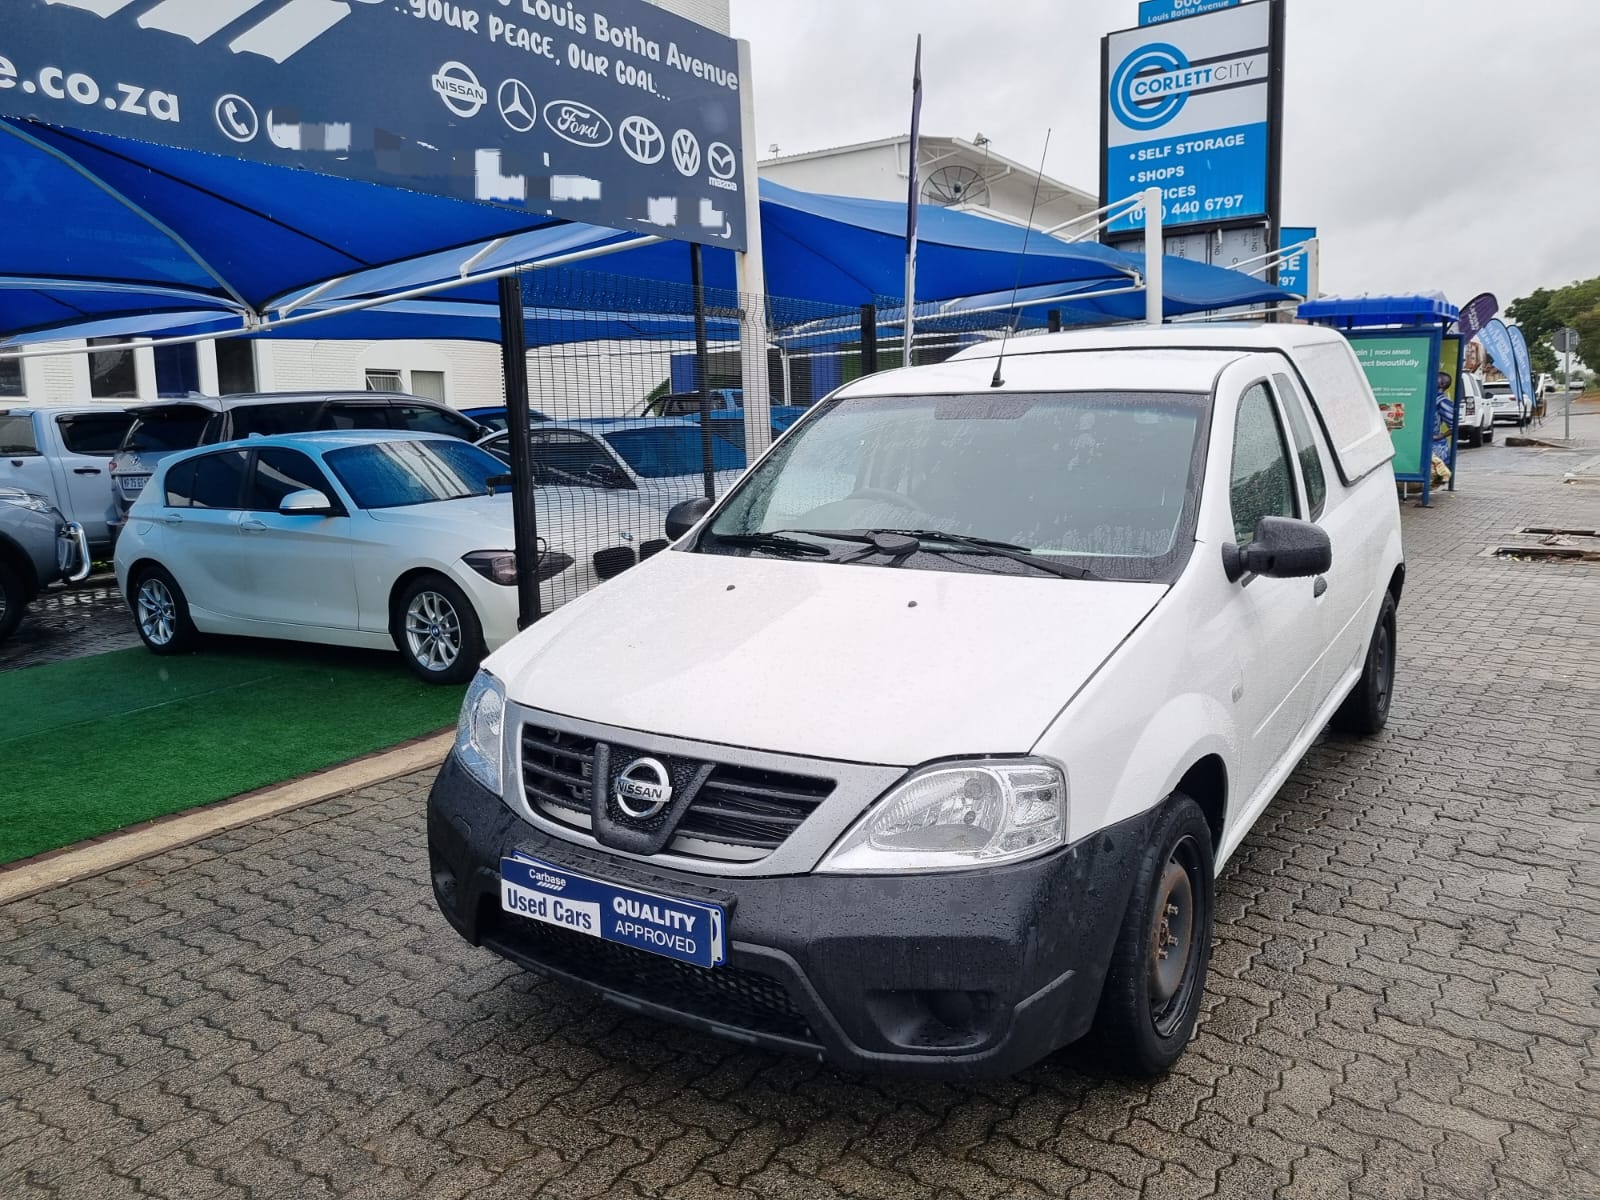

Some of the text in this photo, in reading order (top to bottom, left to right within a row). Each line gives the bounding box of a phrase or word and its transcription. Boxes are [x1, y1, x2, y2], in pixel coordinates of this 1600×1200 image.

[1148, 1, 1229, 23] Louis Botha Avenue
[522, 0, 738, 91] Louis Botha Avenue
[568, 43, 609, 77] OUR
[435, 78, 485, 101] NISSAN
[557, 106, 600, 140] Ford
[1138, 133, 1245, 161] SELF STORAGE
[1137, 165, 1185, 183] SHOPS
[1171, 200, 1200, 215] 440
[1204, 194, 1244, 212] 6797
[616, 780, 663, 800] NISSAN
[528, 868, 567, 887] Carbase
[507, 887, 592, 930] Used Cars
[612, 895, 697, 933] QUALITY
[615, 920, 697, 954] APPROVED
